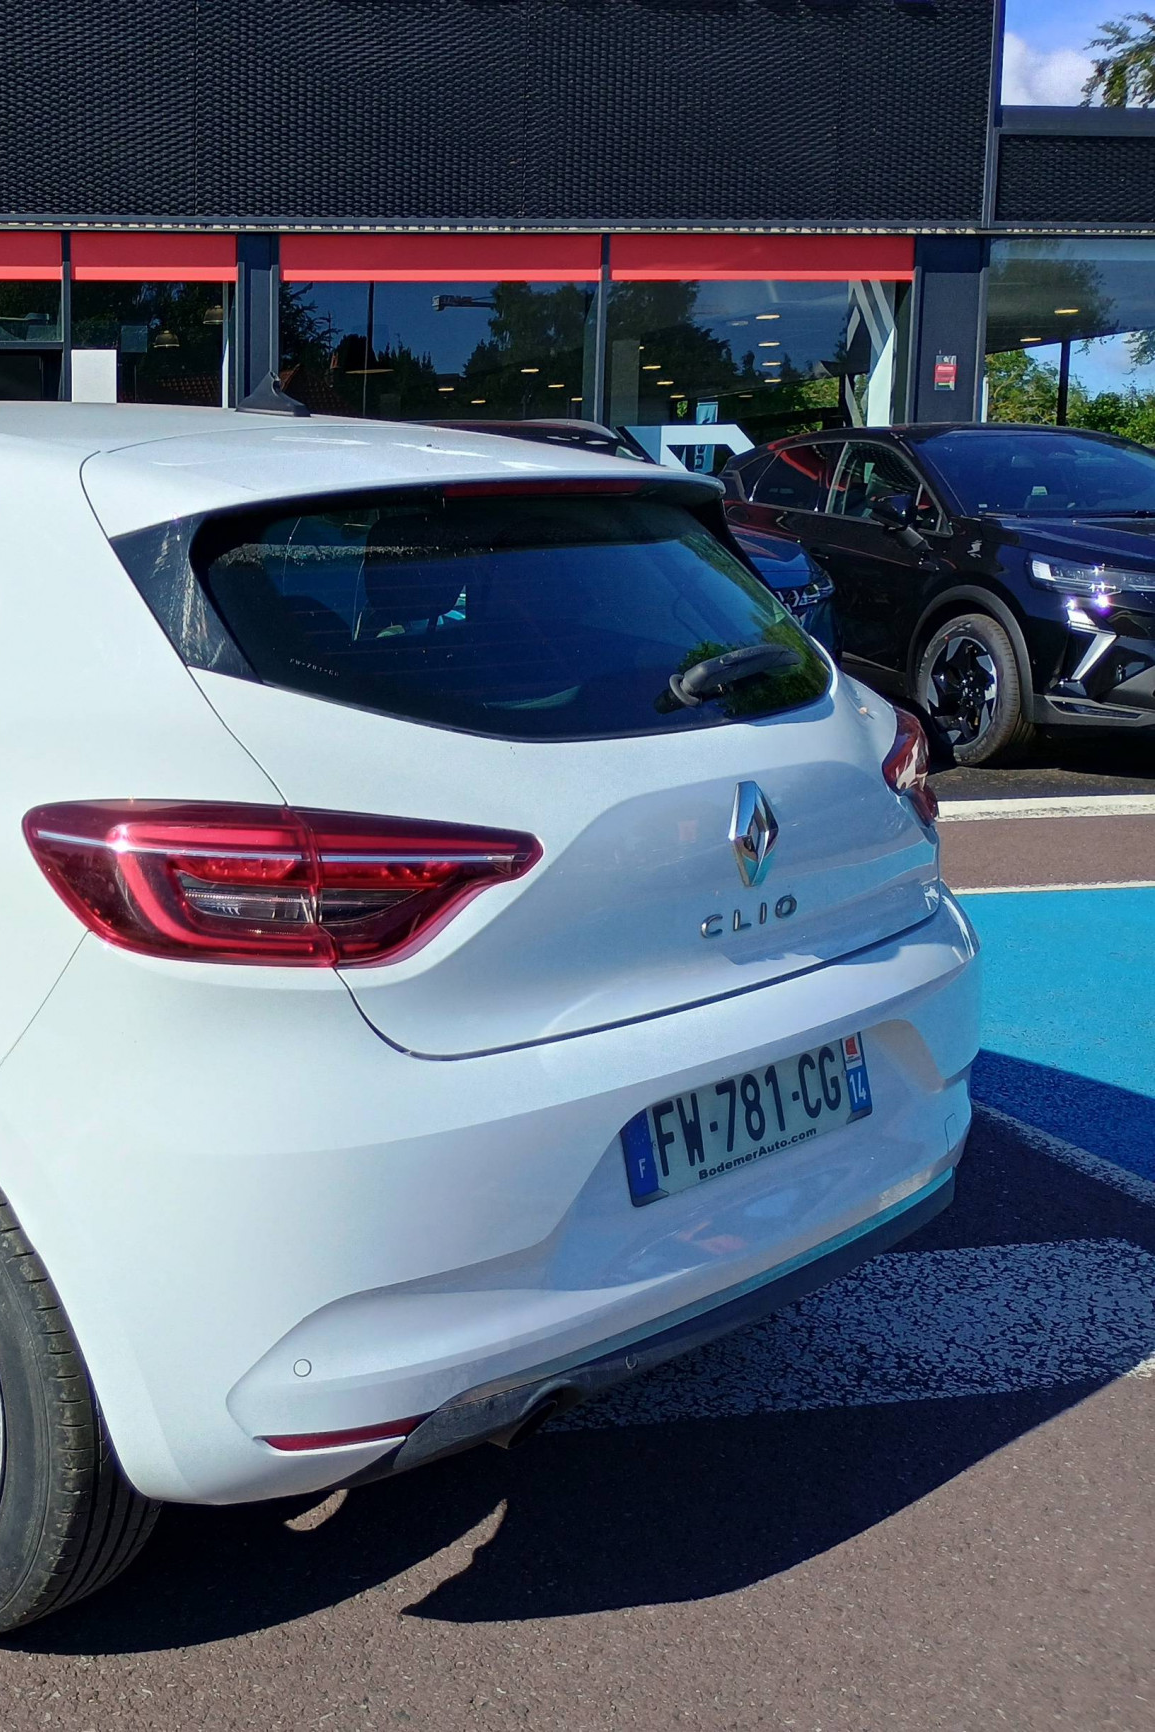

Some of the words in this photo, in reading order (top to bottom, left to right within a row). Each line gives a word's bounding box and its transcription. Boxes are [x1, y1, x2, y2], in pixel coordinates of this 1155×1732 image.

[701, 894, 797, 939] CLIO
[849, 1071, 867, 1104] 14
[638, 1158, 646, 1179] F
[698, 1127, 818, 1180] BodemerAuto.com
